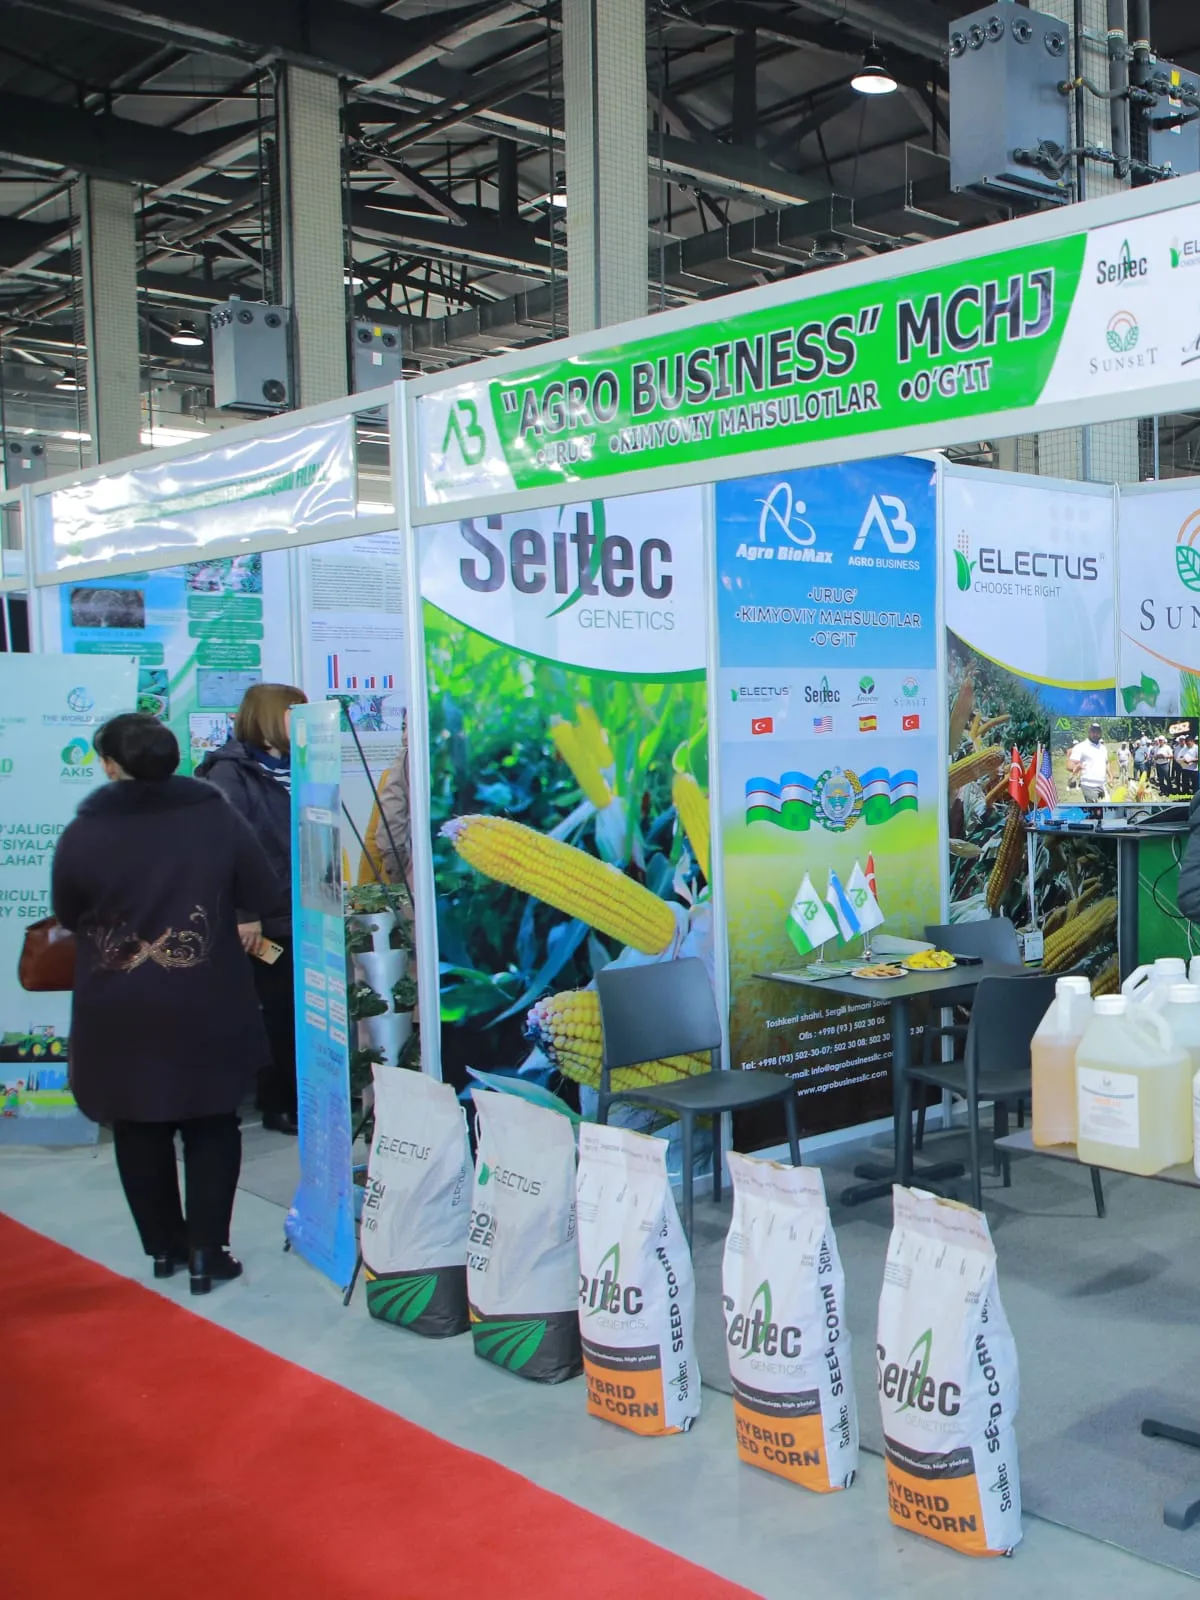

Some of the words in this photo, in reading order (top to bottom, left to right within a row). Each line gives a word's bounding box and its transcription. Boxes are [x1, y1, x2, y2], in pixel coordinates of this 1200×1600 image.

[1097, 256, 1148, 285] Seitec
[898, 269, 1055, 362] MCHJ
[720, 381, 880, 436] MAHSULOTLAR
[459, 511, 673, 599] Seitec
[736, 543, 773, 560] Agro
[777, 546, 833, 564] BioMax
[848, 556, 874, 567] AGRO
[875, 558, 920, 571] BUSINESS
[979, 548, 1098, 581] ELECTUS
[974, 581, 1014, 595] CHOOSE
[1015, 584, 1032, 596] THE
[1034, 585, 1061, 598] RIGHT
[578, 609, 675, 631] GENETICS
[819, 610, 921, 628] MAHSULOTLAR
[739, 686, 789, 697] ELECTUS
[805, 685, 840, 704] Seitec
[61, 714, 93, 722] WORLD
[60, 767, 94, 777] AKIS
[0, 839, 56, 851] SIYALA
[766, 1014, 800, 1029] Toshkent
[818, 1027, 835, 1036] +998
[853, 1020, 866, 1030] 502
[867, 1018, 876, 1027] 30
[741, 1061, 757, 1072] Tel:
[758, 1057, 777, 1067] +998
[778, 1053, 793, 1065] (93)
[834, 1043, 847, 1053] 502
[847, 1040, 856, 1049] 30
[869, 1035, 881, 1045] 502
[882, 1032, 891, 1041] 30
[656, 1247, 679, 1296] CORN
[821, 1284, 840, 1343] CORN
[670, 1302, 684, 1354] SEED
[975, 1334, 1000, 1397] CORN
[677, 1360, 689, 1402] Seitec
[605, 1399, 660, 1417] CORN
[840, 1404, 850, 1449] Seitec
[764, 1447, 820, 1467] CORN
[1000, 1463, 1012, 1513] Seitec
[915, 1506, 977, 1533] CORN
